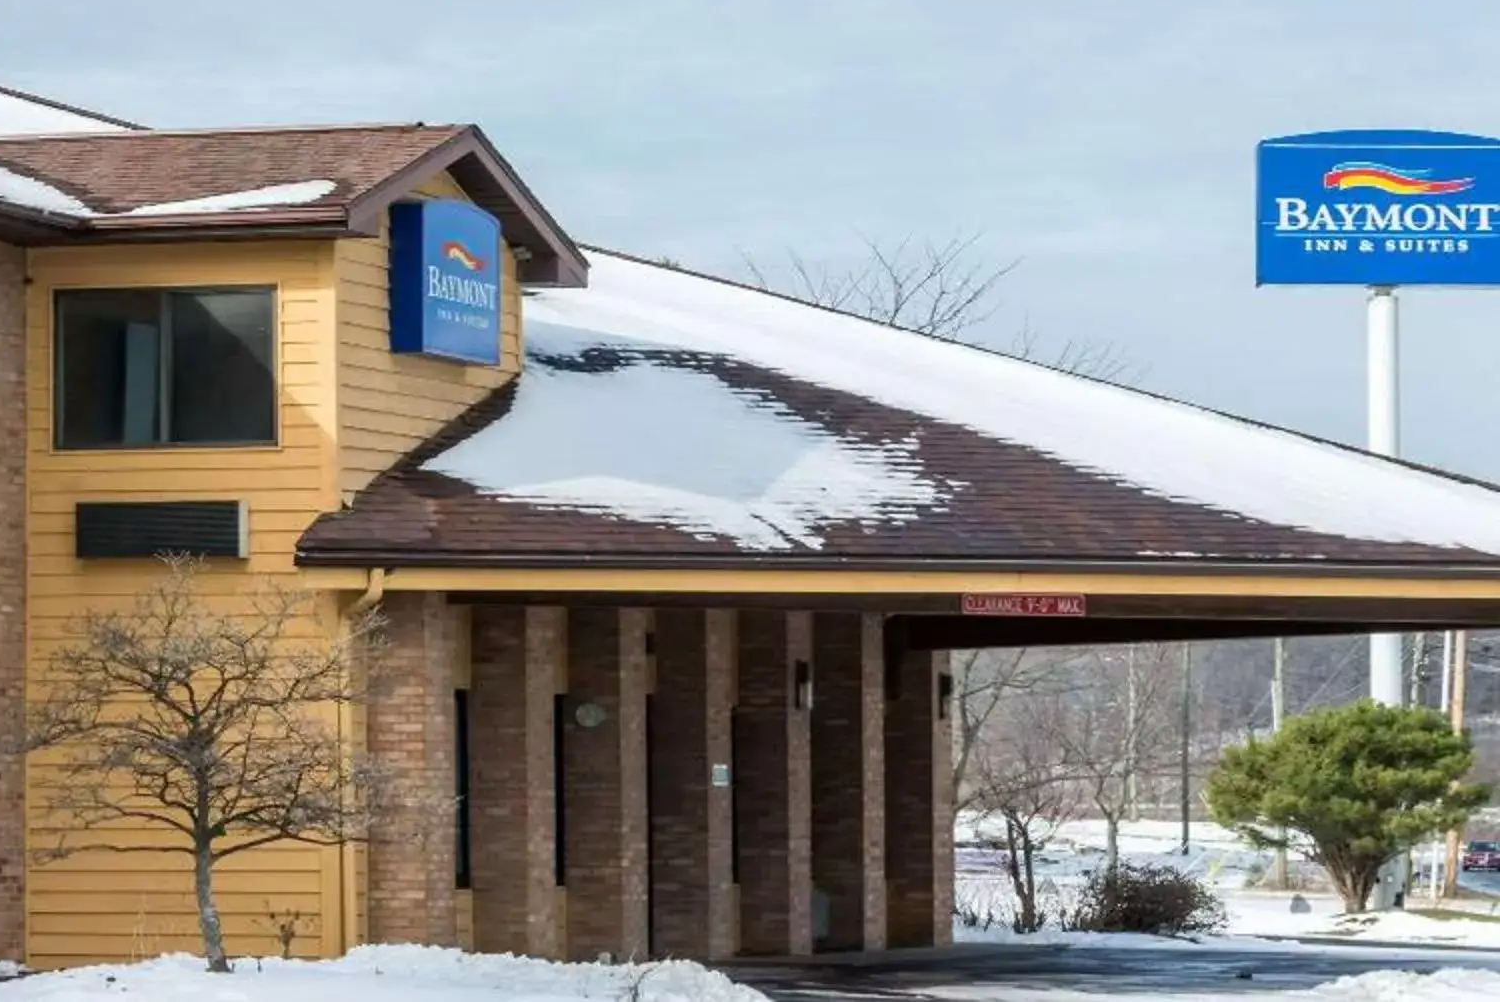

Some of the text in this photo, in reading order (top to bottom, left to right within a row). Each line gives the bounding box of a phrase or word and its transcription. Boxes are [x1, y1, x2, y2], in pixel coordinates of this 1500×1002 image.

[1275, 198, 1500, 231] BAYMONT
[1304, 239, 1470, 253] INN & SUITES
[428, 265, 497, 311] BAYMONT
